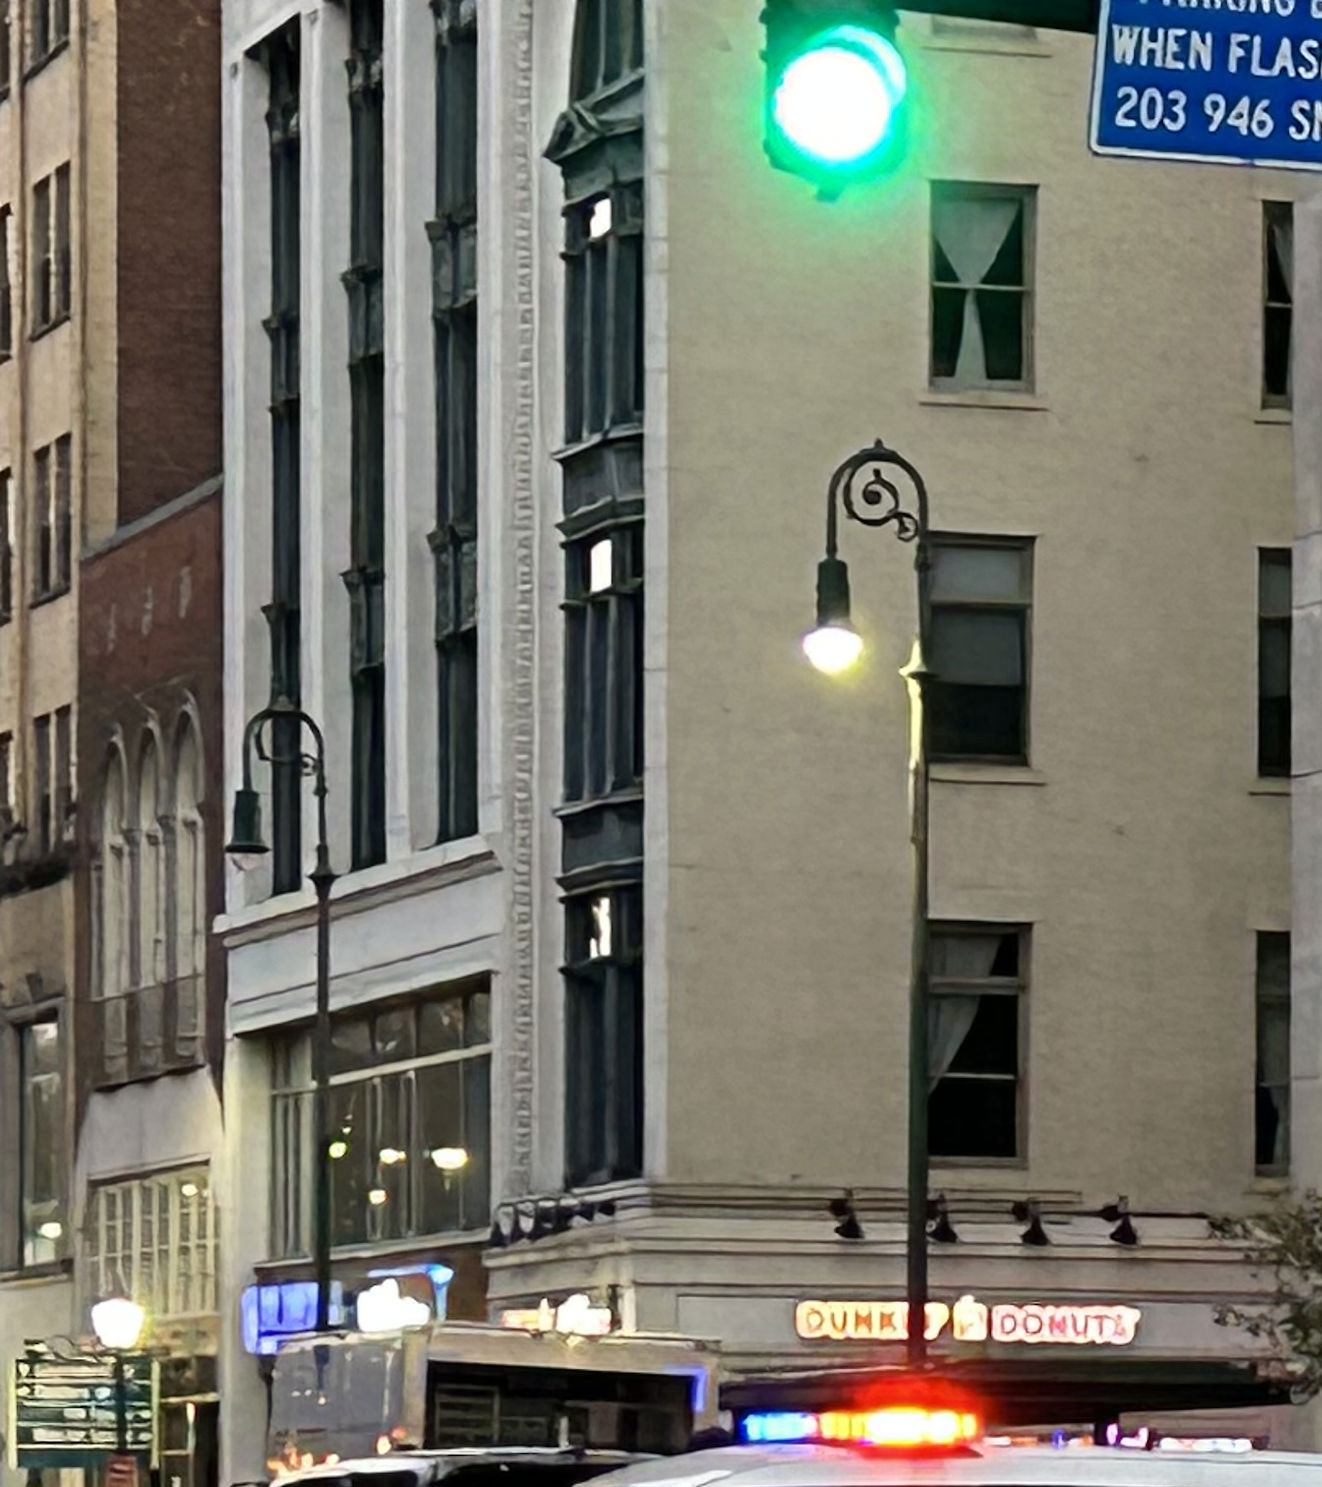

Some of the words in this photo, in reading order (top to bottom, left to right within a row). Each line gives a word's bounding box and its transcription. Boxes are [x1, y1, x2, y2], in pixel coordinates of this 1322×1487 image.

[1112, 23, 1213, 72] WHEN
[1115, 86, 1188, 132] 203
[1203, 93, 1275, 139] 946
